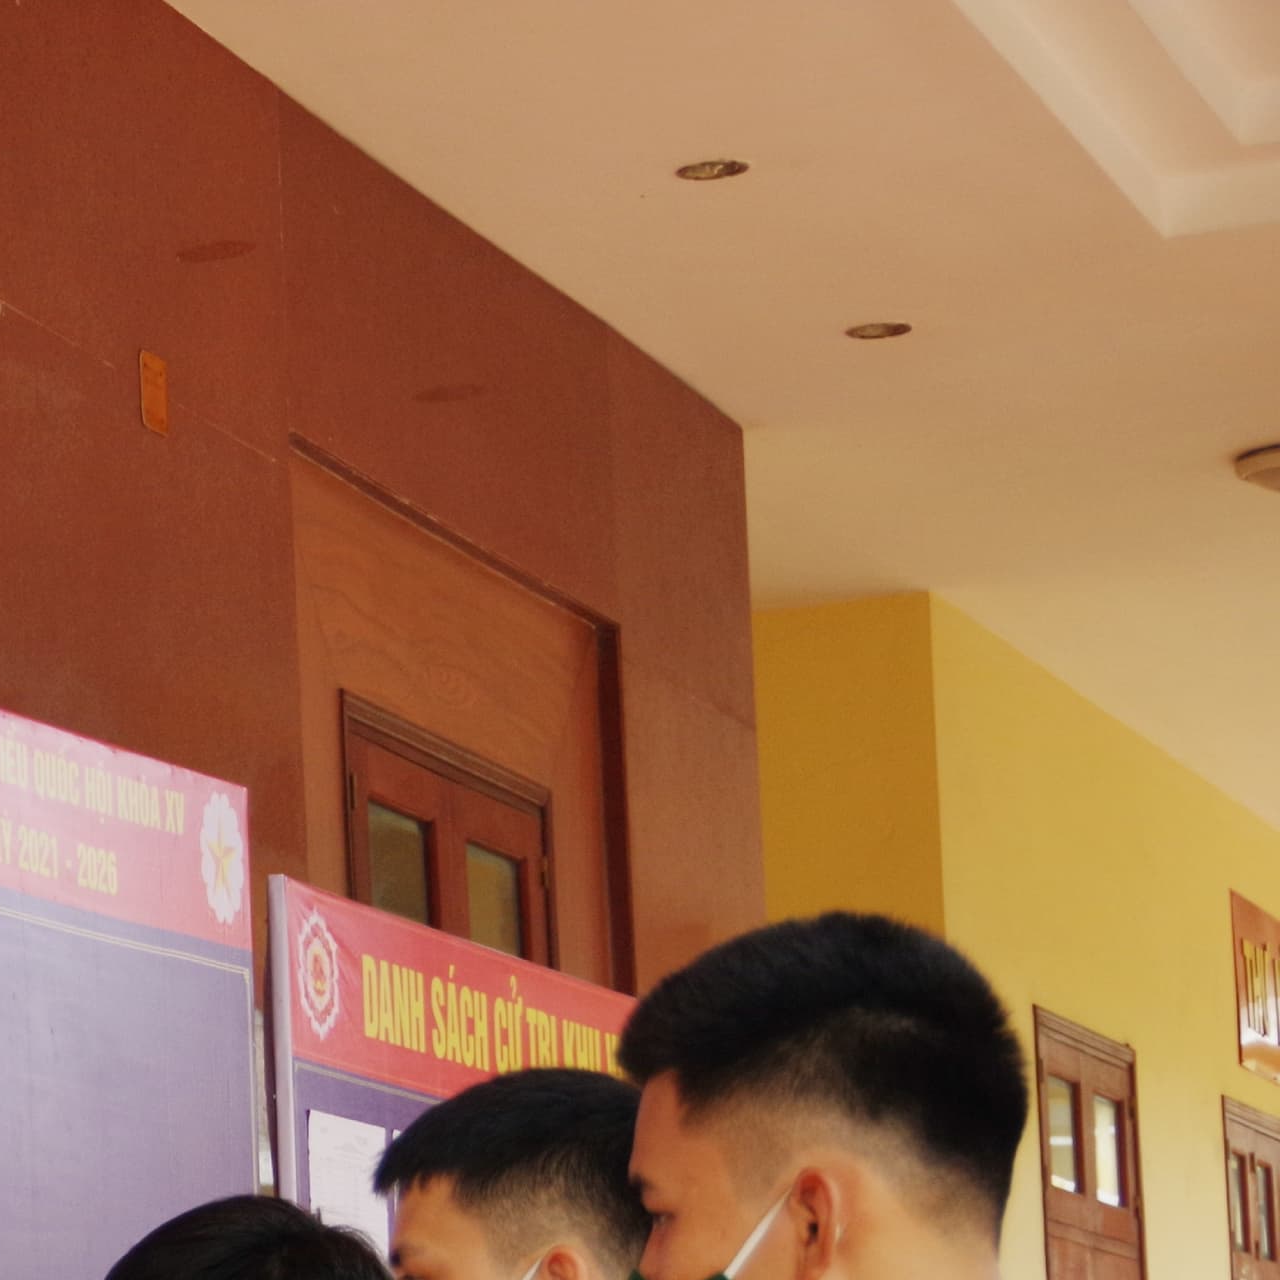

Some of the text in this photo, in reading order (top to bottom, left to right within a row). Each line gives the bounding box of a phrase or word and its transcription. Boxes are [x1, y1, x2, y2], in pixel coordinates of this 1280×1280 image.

[18, 825, 61, 880] 2021
[77, 849, 119, 896] 2026
[361, 953, 426, 1053] DANH
[431, 965, 489, 1072] SÁCH
[494, 975, 524, 1074] CỬ
[525, 1007, 558, 1069] TRI
